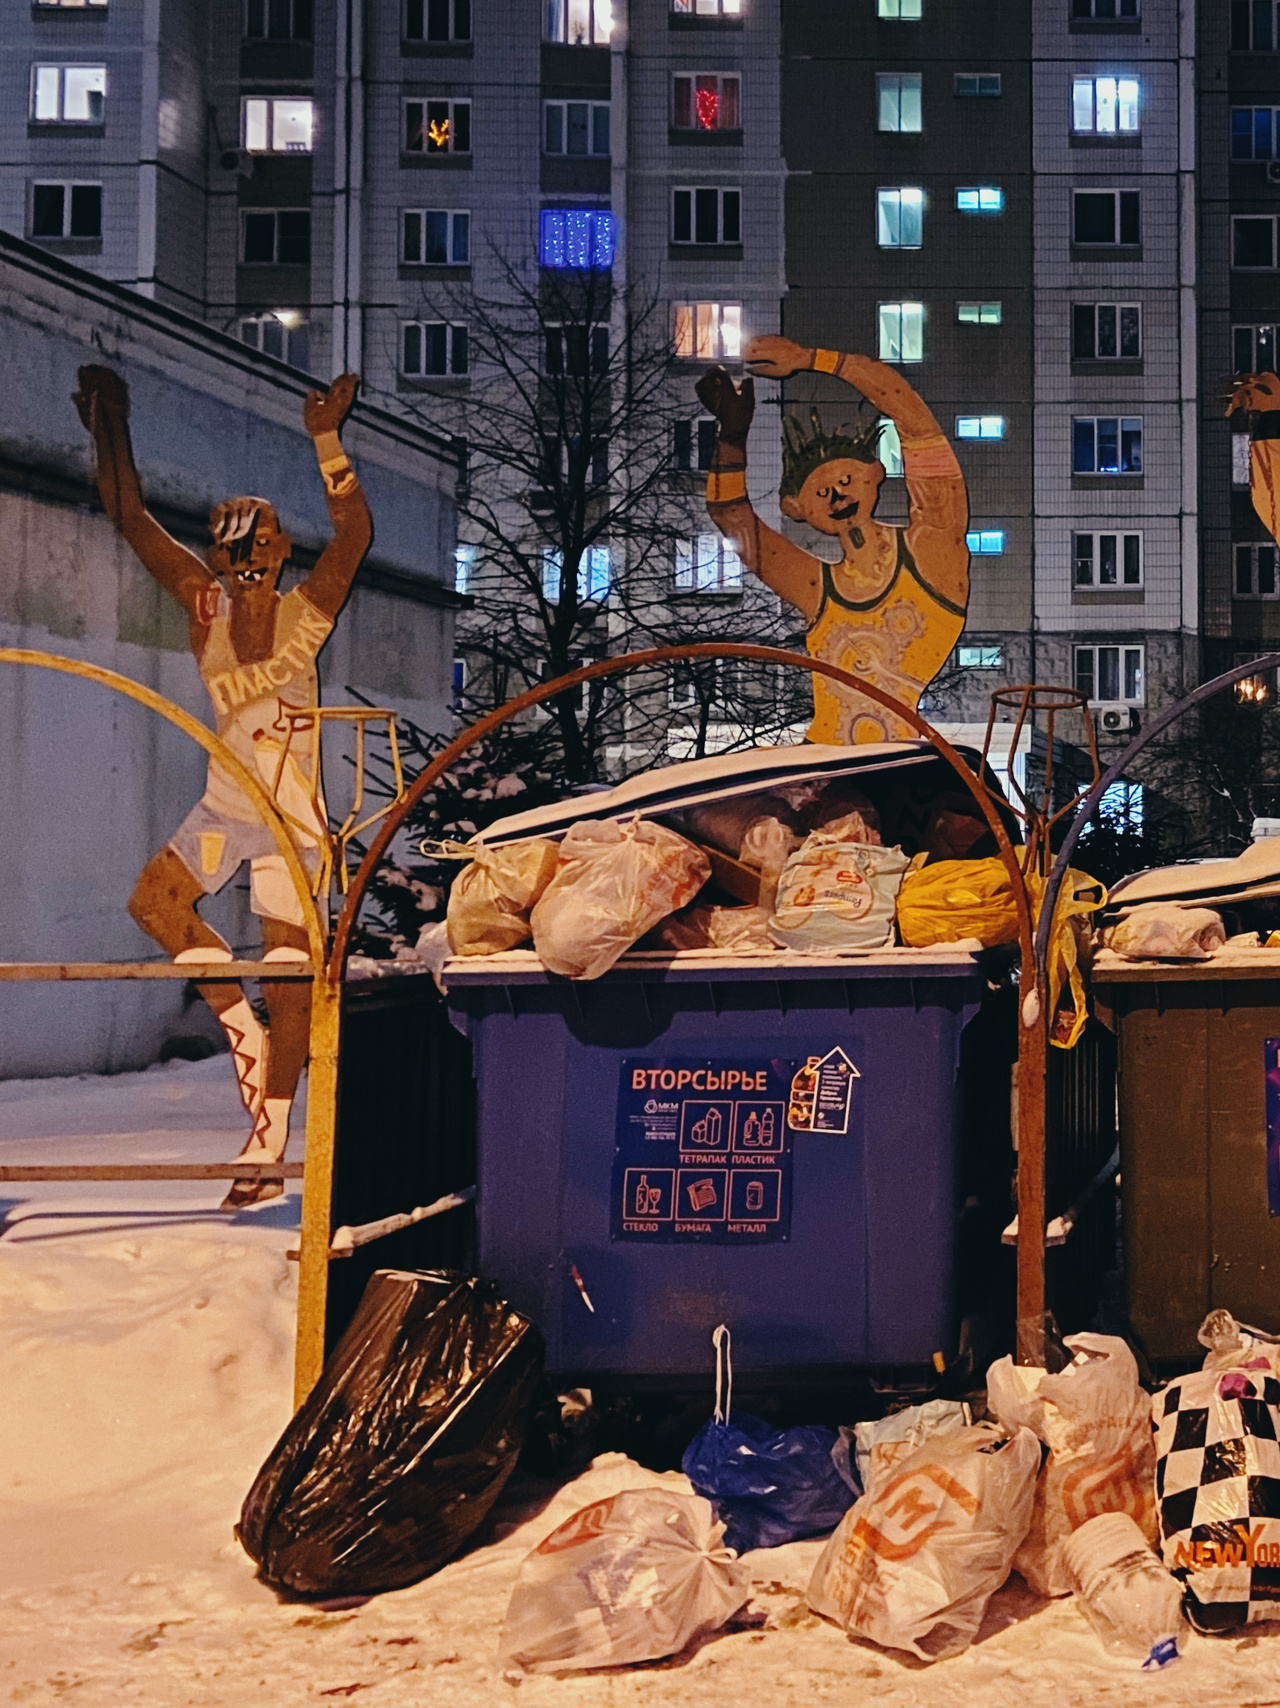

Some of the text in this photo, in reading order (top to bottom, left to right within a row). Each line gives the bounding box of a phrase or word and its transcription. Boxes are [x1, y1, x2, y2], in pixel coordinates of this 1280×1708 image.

[211, 607, 331, 715] ПЛАСТИК
[631, 1069, 768, 1091] ВТОРСЫРЬЕ
[679, 1154, 775, 1165] ТЕТРАПАК ПЛАСТИК
[622, 1222, 767, 1233] СТЕКЛО БУМАГА МЕТАЛЛ
